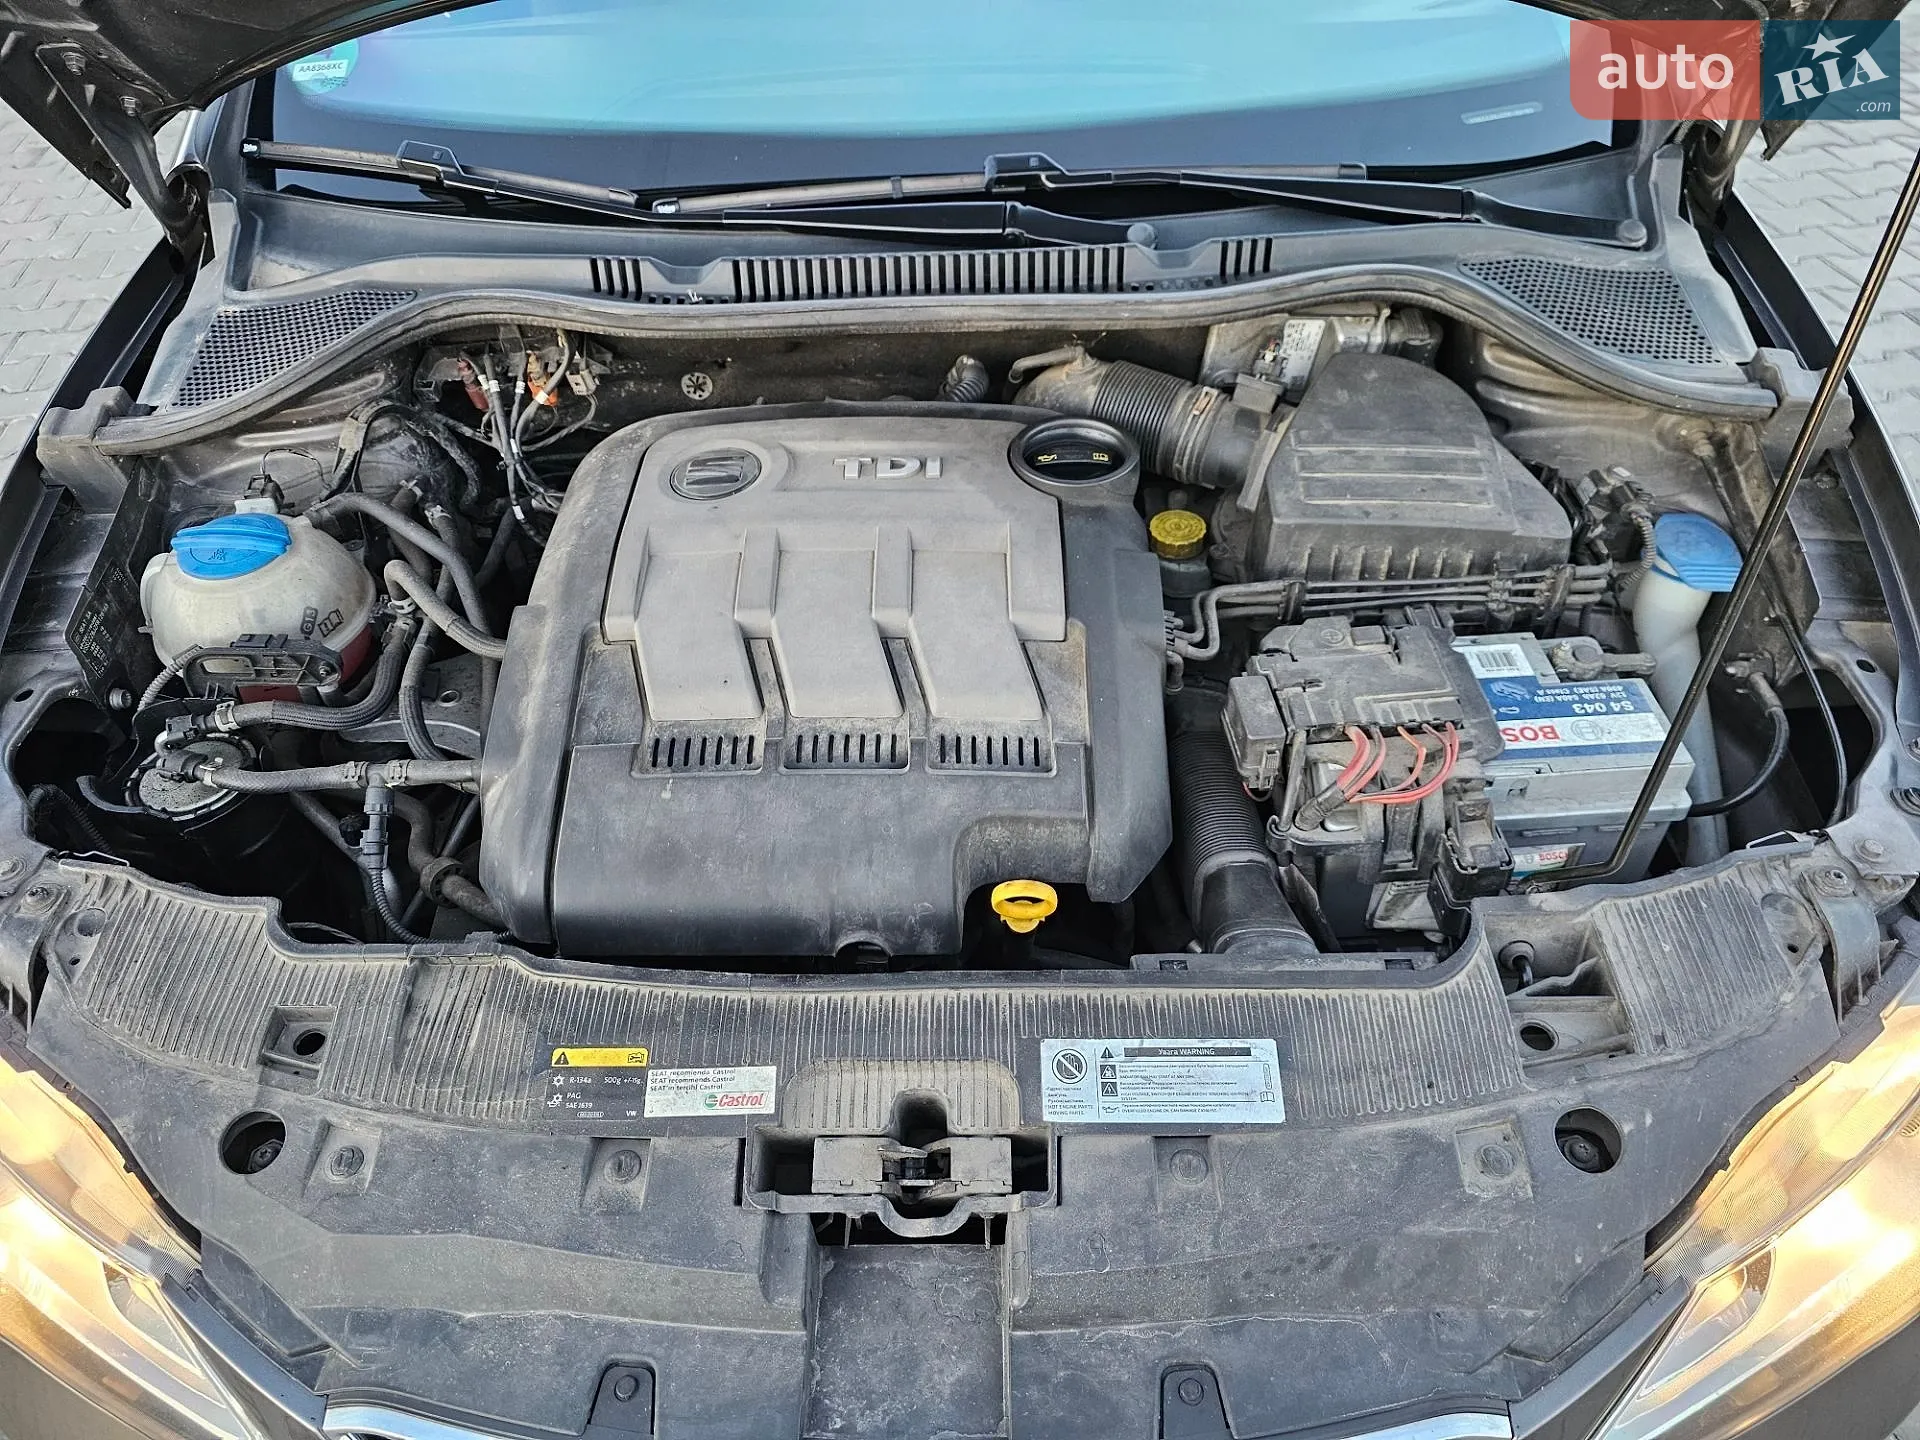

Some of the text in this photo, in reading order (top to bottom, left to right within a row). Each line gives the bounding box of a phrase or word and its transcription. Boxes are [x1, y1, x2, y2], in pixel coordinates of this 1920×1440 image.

[832, 457, 943, 480] TDI
[1572, 700, 1635, 714] S4 043
[1499, 724, 1561, 742] BOS
[1179, 1048, 1216, 1056] WARNING
[718, 1092, 765, 1107] Castrol
